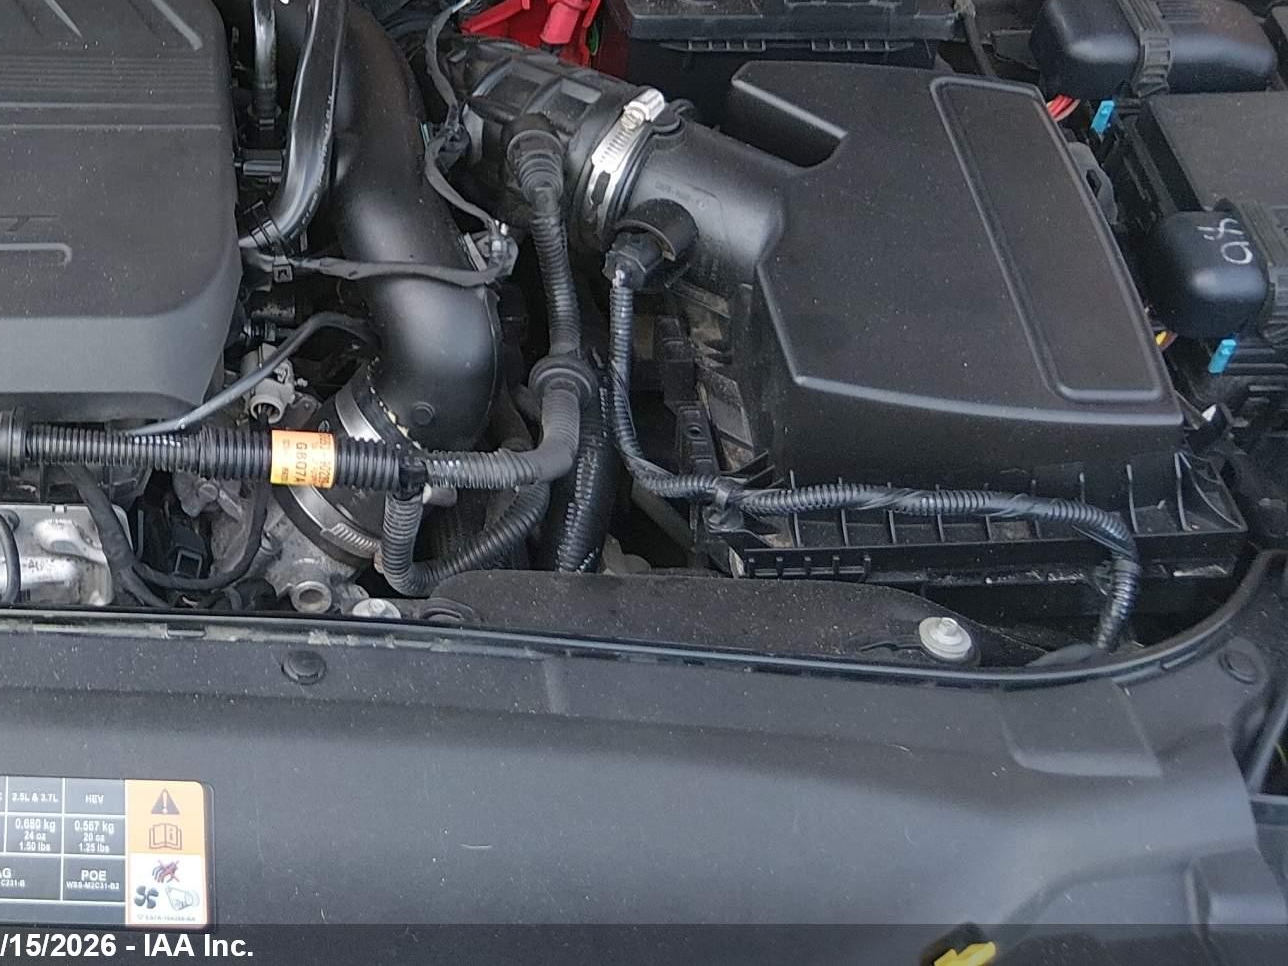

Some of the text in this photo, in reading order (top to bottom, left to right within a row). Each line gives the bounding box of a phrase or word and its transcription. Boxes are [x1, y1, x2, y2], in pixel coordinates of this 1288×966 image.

[85, 795, 104, 803] HEV
[44, 819, 56, 832] kg
[102, 821, 114, 834] kg
[38, 842, 50, 851] lbs
[97, 843, 110, 853] lbs
[81, 870, 106, 880] POE
